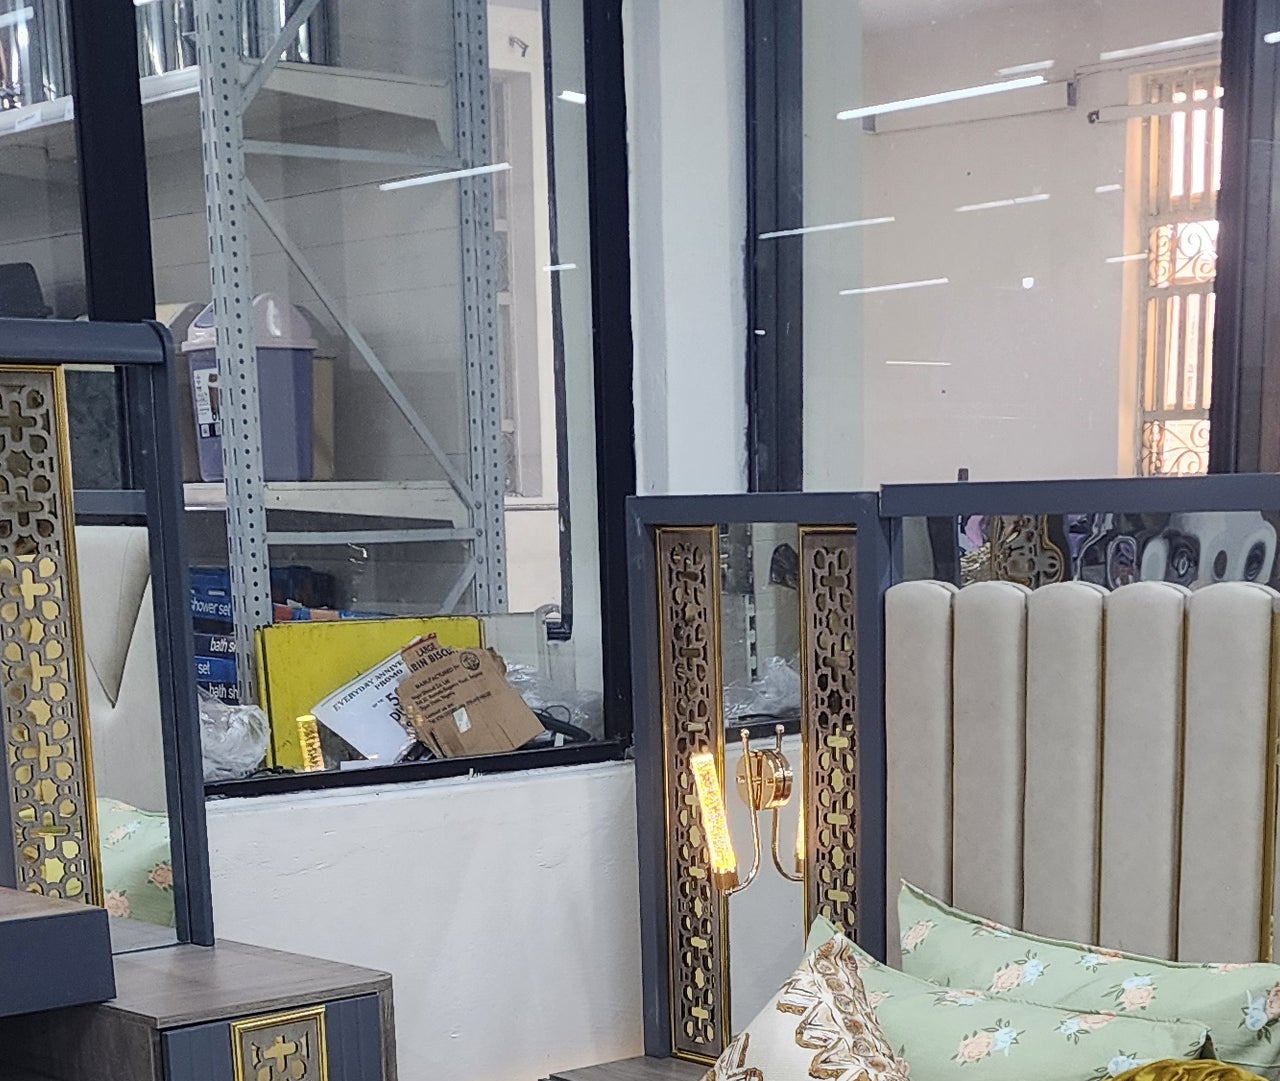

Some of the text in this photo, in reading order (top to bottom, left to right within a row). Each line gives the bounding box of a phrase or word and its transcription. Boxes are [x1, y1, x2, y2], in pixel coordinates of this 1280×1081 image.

[218, 603, 231, 616] set
[209, 636, 227, 652] bath
[415, 642, 437, 657] LARGE
[375, 669, 403, 690] PROMO
[333, 679, 374, 711] EVERYDAY
